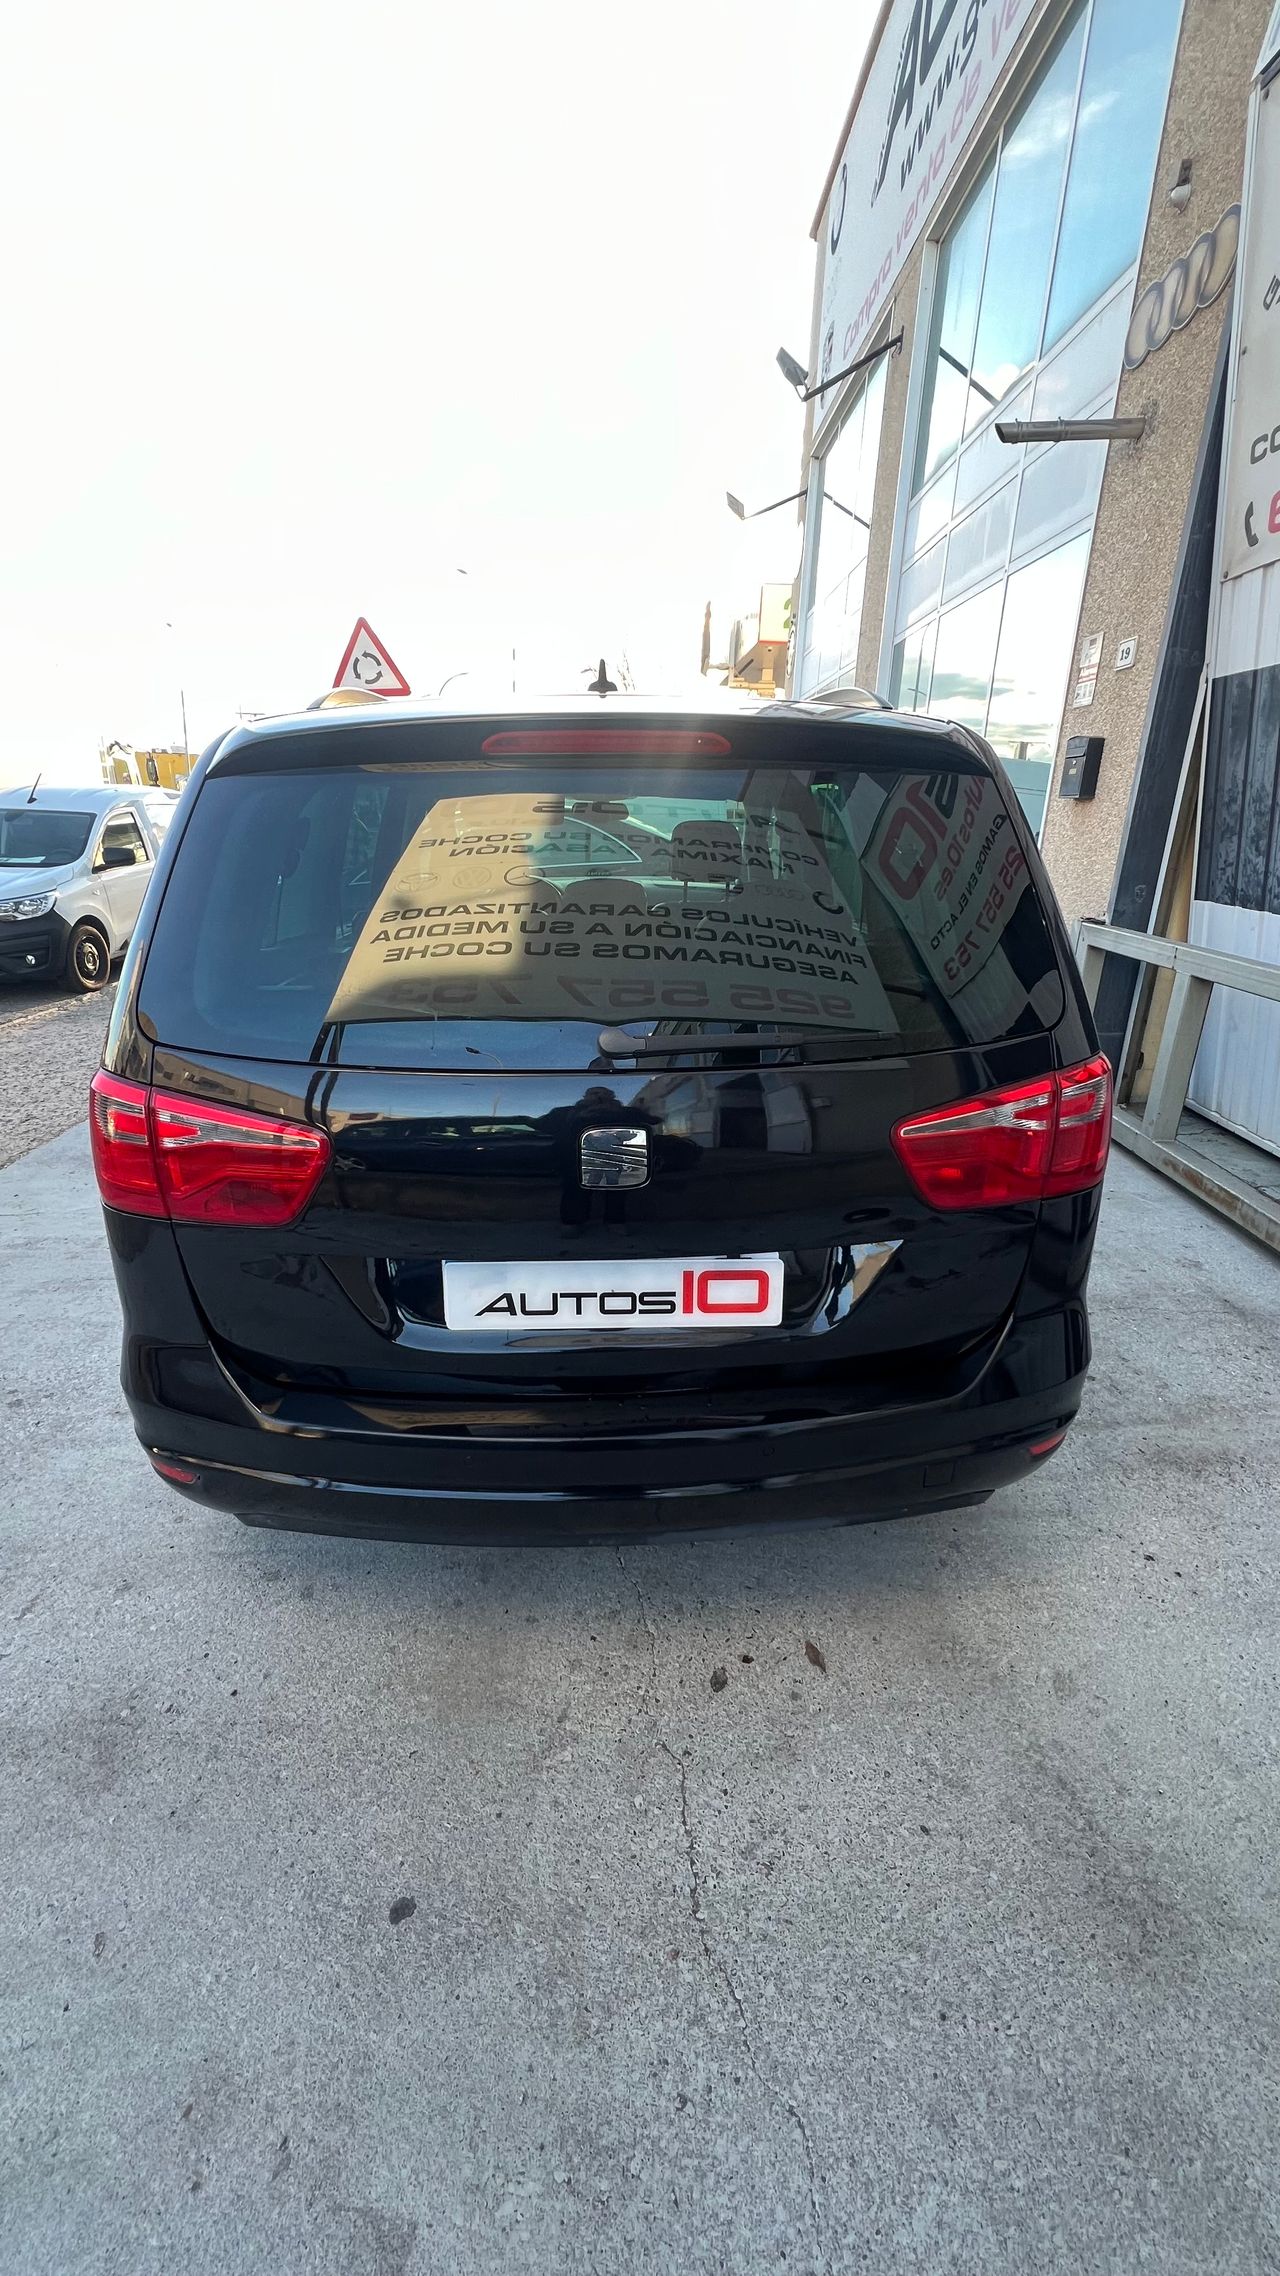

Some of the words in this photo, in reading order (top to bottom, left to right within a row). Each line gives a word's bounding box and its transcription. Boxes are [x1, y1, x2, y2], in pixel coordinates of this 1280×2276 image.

[900, 0, 988, 192] www.g
[950, 59, 982, 144] de
[1119, 647, 1131, 662] 19
